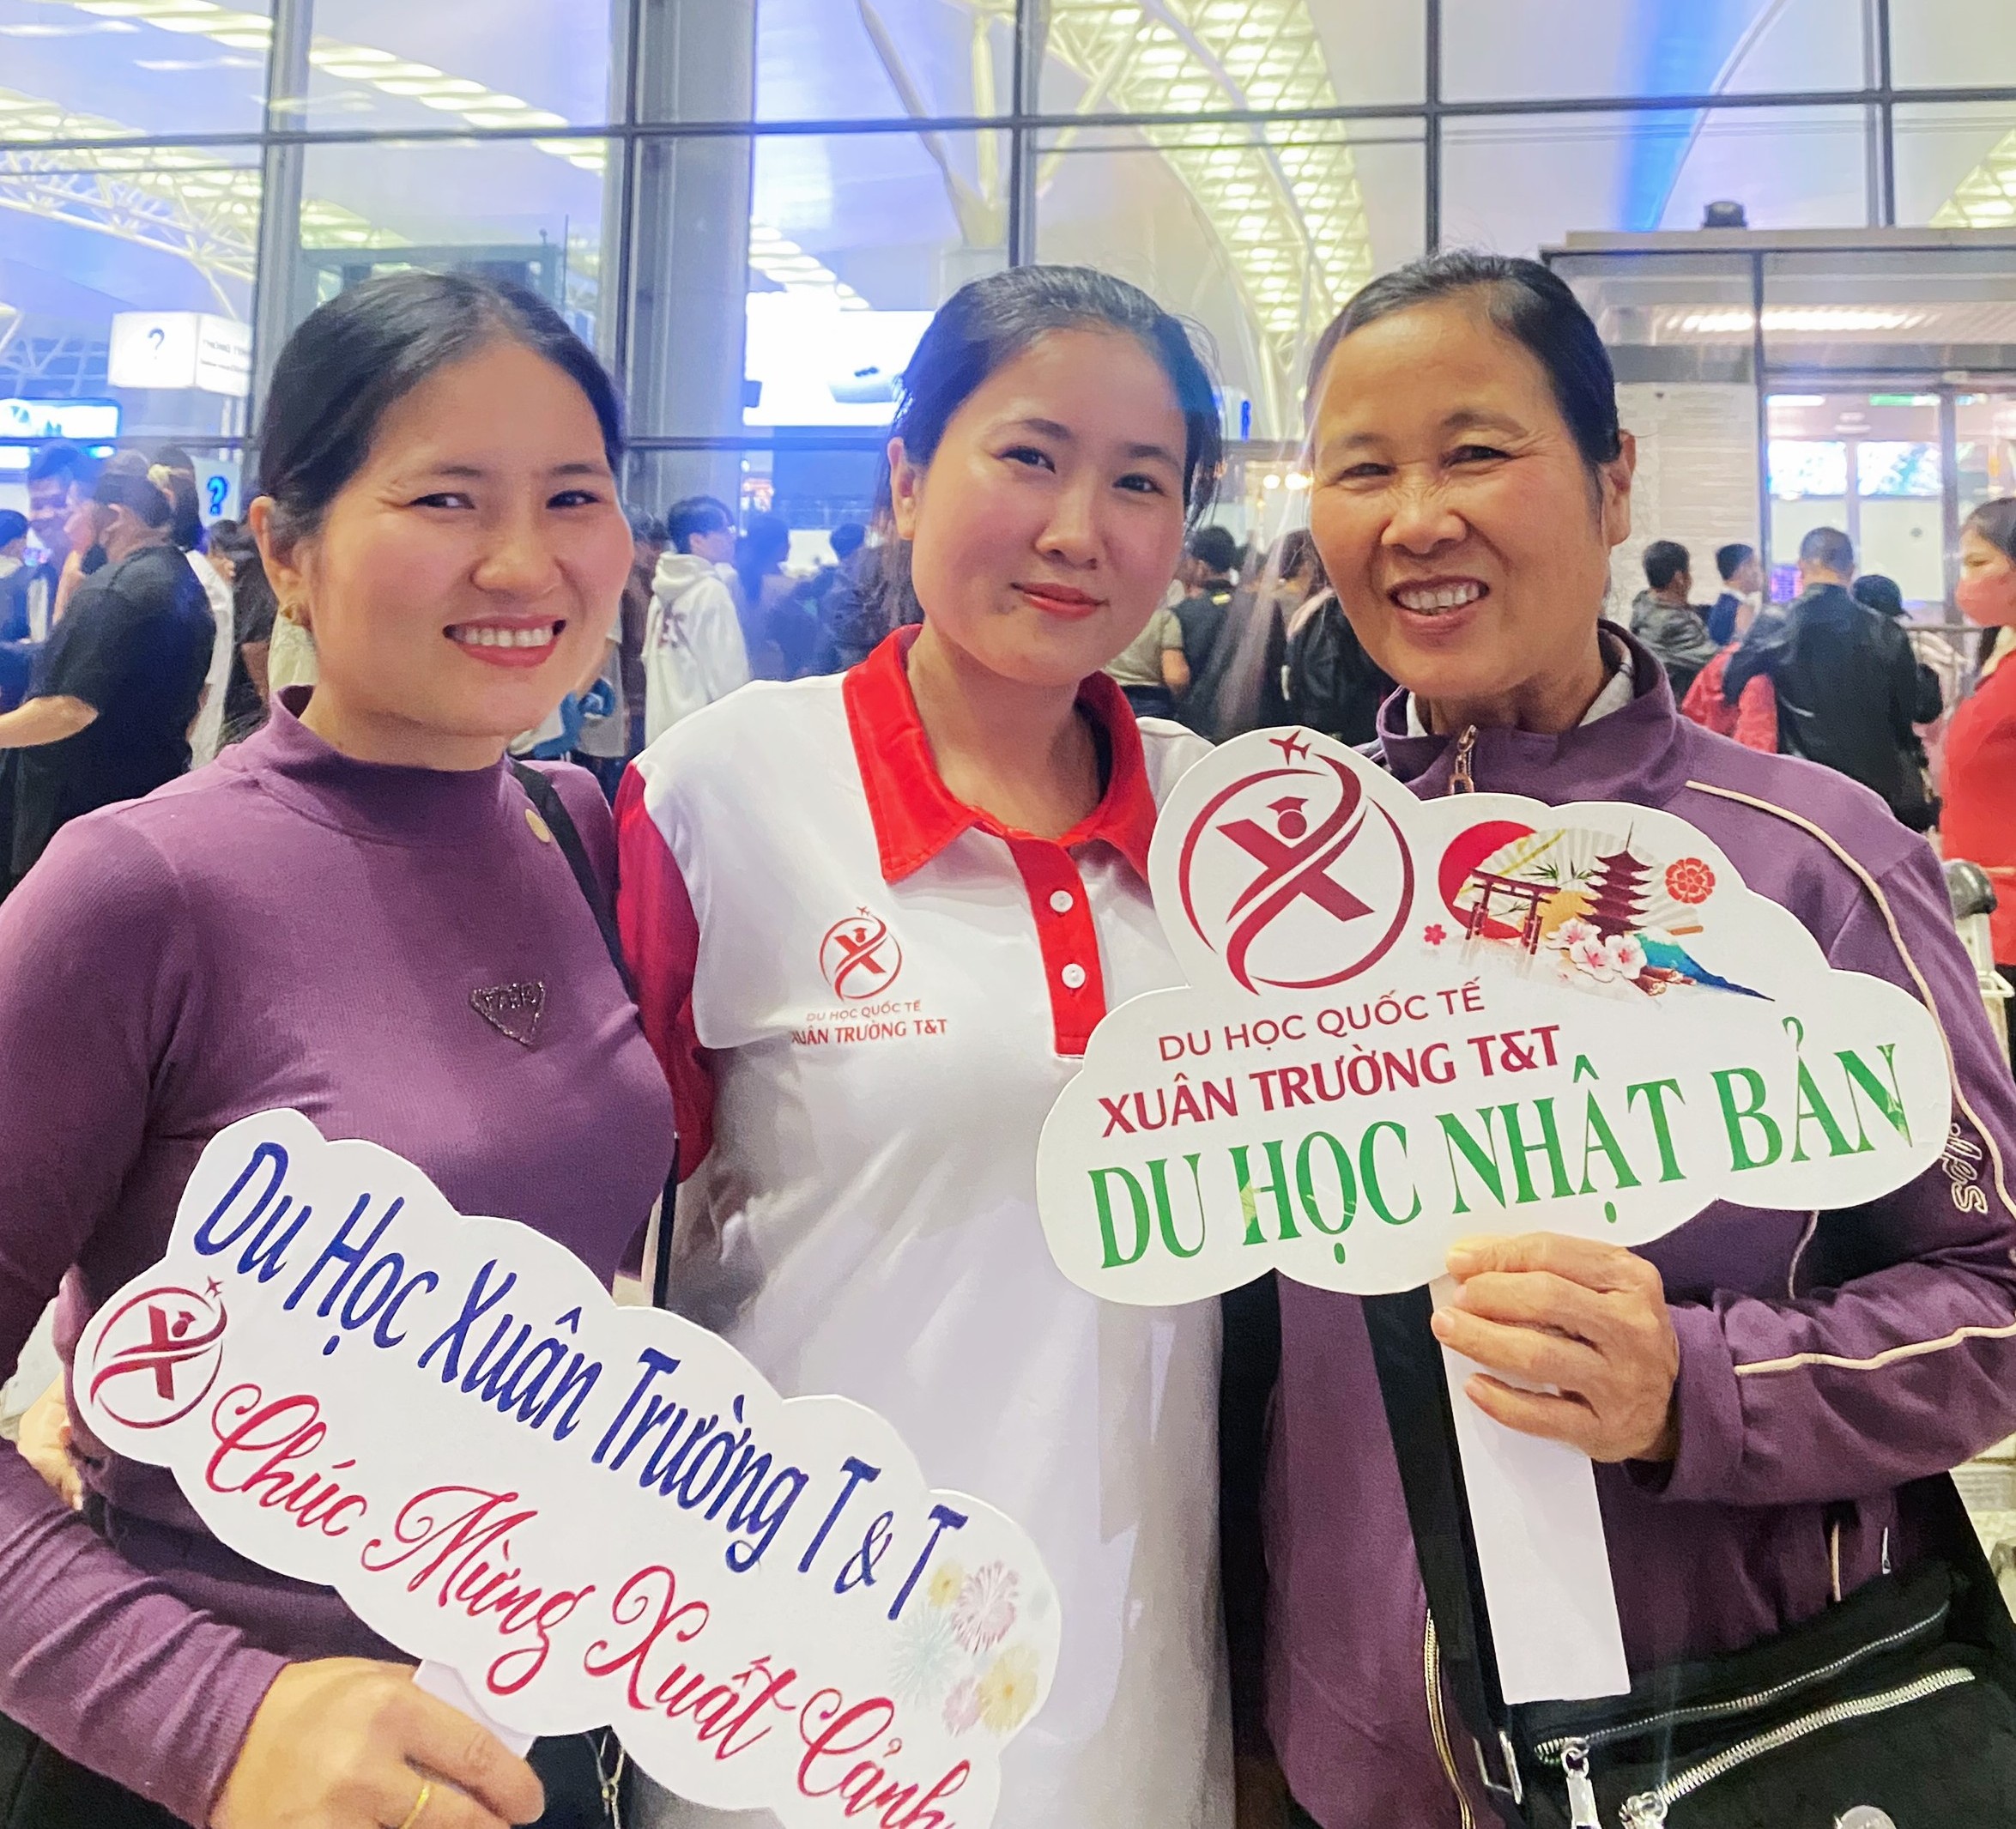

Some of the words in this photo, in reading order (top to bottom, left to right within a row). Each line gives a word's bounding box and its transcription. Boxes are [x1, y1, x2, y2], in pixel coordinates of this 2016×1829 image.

[207, 476, 228, 516] ?
[806, 1012, 826, 1022] DU
[829, 1008, 858, 1022] HỌC
[861, 1000, 901, 1018] QUỐC
[905, 999, 922, 1013] TẾ
[913, 1018, 947, 1036] T&T
[1159, 1029, 1212, 1062] DU
[1225, 1014, 1306, 1051] HỌC
[1317, 990, 1429, 1035] QUỐC
[1438, 977, 1486, 1016] TẾ
[1099, 1073, 1238, 1138] XUÂN
[1249, 1043, 1456, 1111] TRƯỜNG
[1467, 1024, 1560, 1077] T&T
[1087, 1153, 1203, 1269] DU
[1228, 1121, 1422, 1265] HỌC
[1435, 1054, 1686, 1224] NHẬT
[1710, 1016, 1913, 1172] BẢN
[193, 1142, 312, 1284] Du
[282, 1192, 439, 1356] Học
[417, 1259, 602, 1441] Xuân
[591, 1347, 809, 1573] Trường
[797, 1457, 881, 1574] T
[204, 1383, 368, 1537] Chúc
[360, 1485, 596, 1697] Mừng
[584, 1565, 797, 1761] Xuất
[797, 1687, 971, 1829] Cảnh
[834, 1511, 894, 1594] &
[887, 1504, 969, 1621] T
